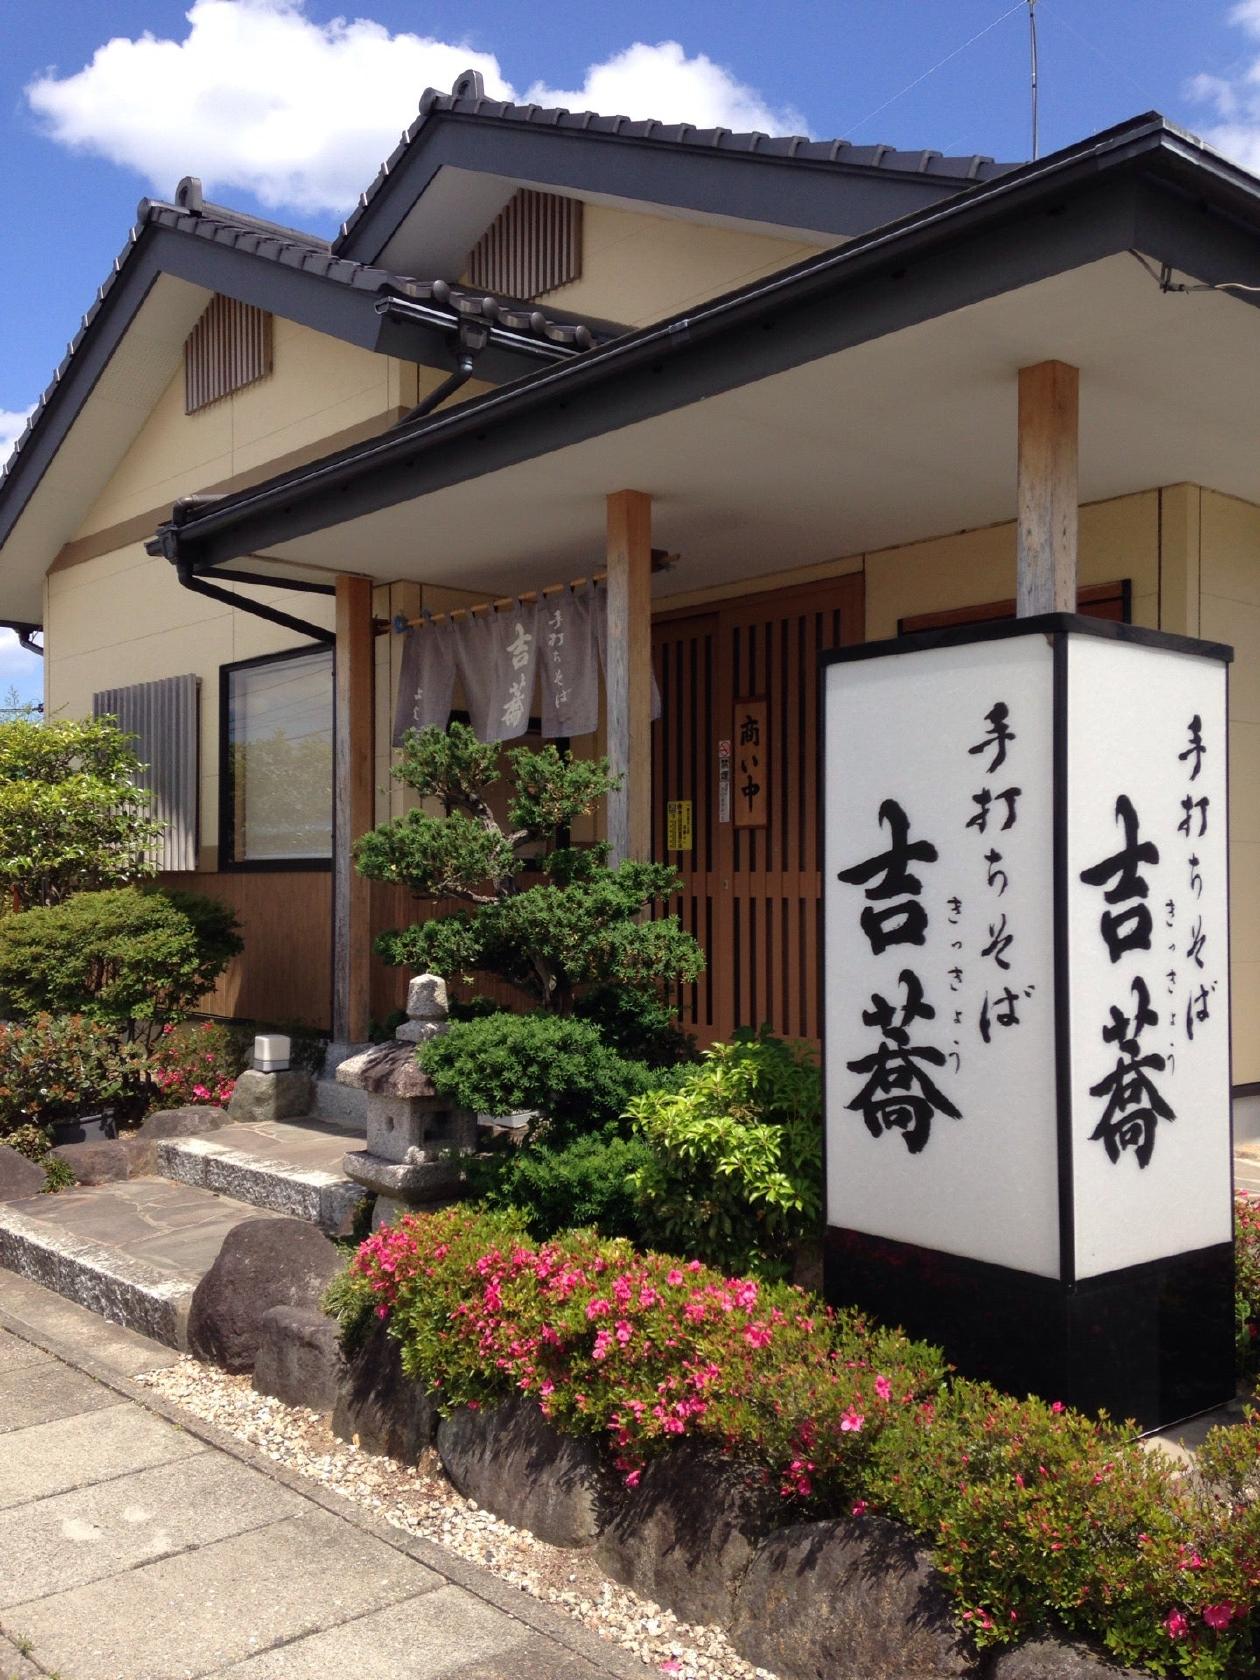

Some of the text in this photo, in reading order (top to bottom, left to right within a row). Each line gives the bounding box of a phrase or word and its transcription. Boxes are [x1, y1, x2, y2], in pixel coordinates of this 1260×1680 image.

[739, 714, 761, 813] 商い中
[965, 700, 1035, 1045] 手打ちそば
[1177, 713, 1218, 1042] 手打ちそば
[837, 797, 964, 1155] 吉蕎
[946, 896, 963, 1074] きっきょう
[1080, 793, 1177, 1170] 吉蕎
